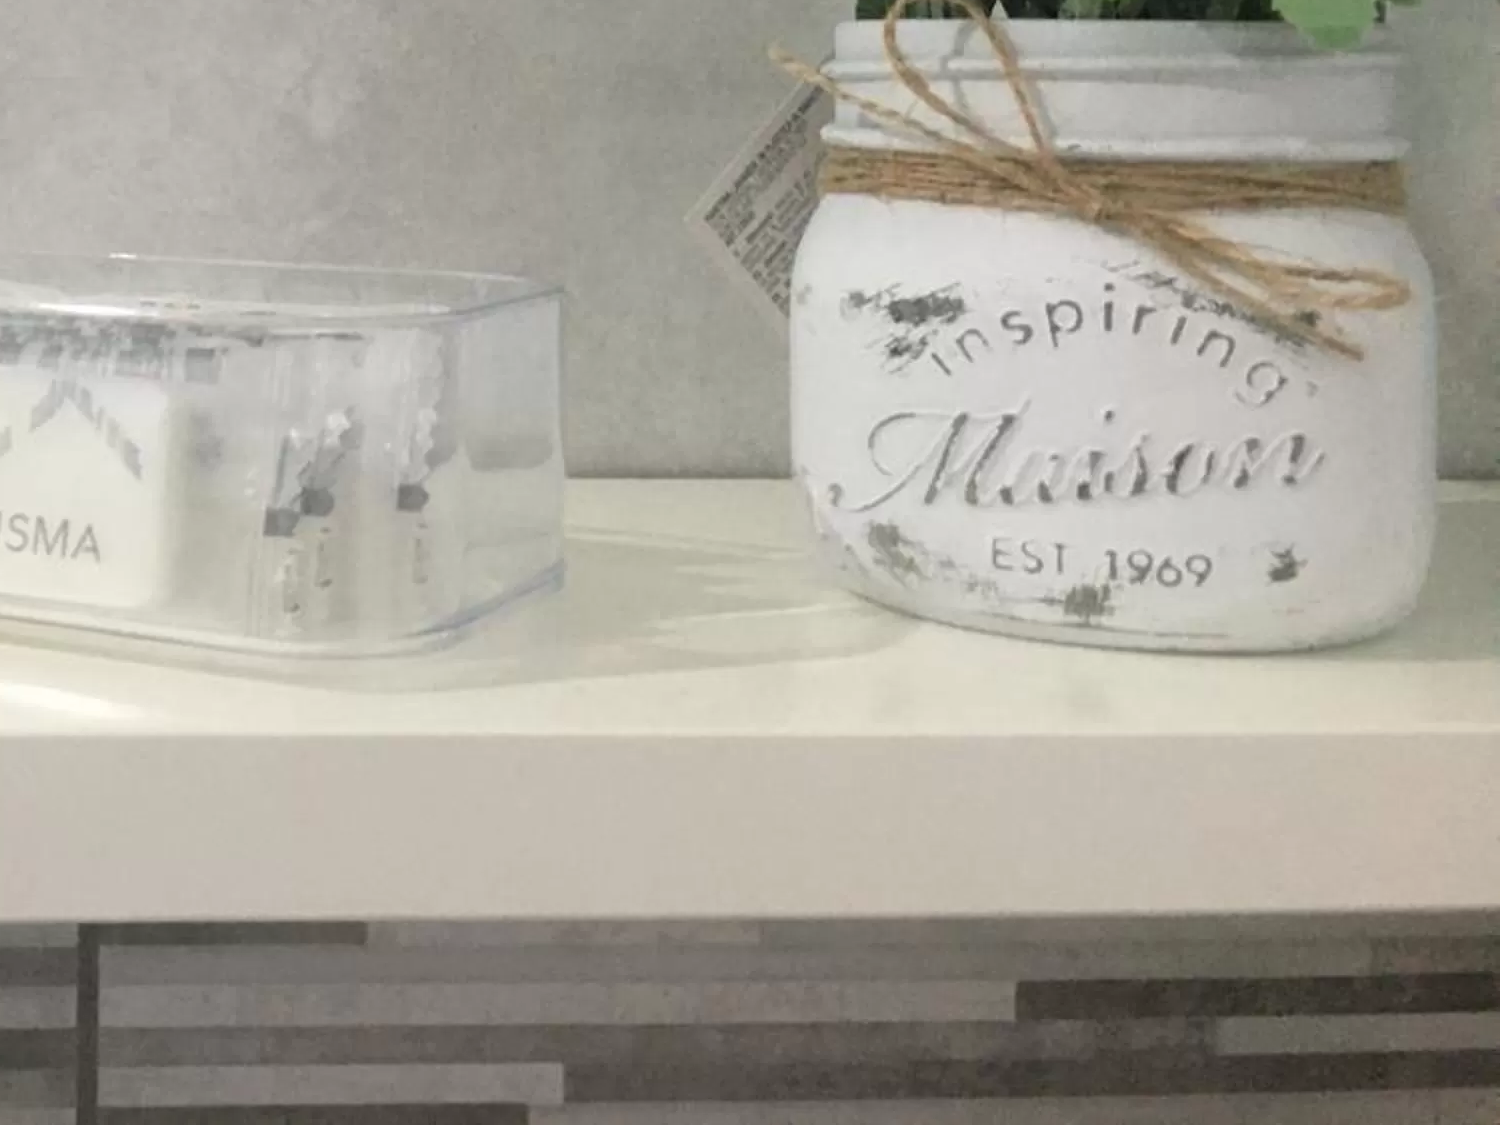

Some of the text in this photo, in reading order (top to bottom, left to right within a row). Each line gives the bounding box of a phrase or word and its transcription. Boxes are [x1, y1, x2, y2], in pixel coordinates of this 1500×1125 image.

[829, 396, 1326, 513] Maison
[990, 536, 1214, 588] EST 1969
